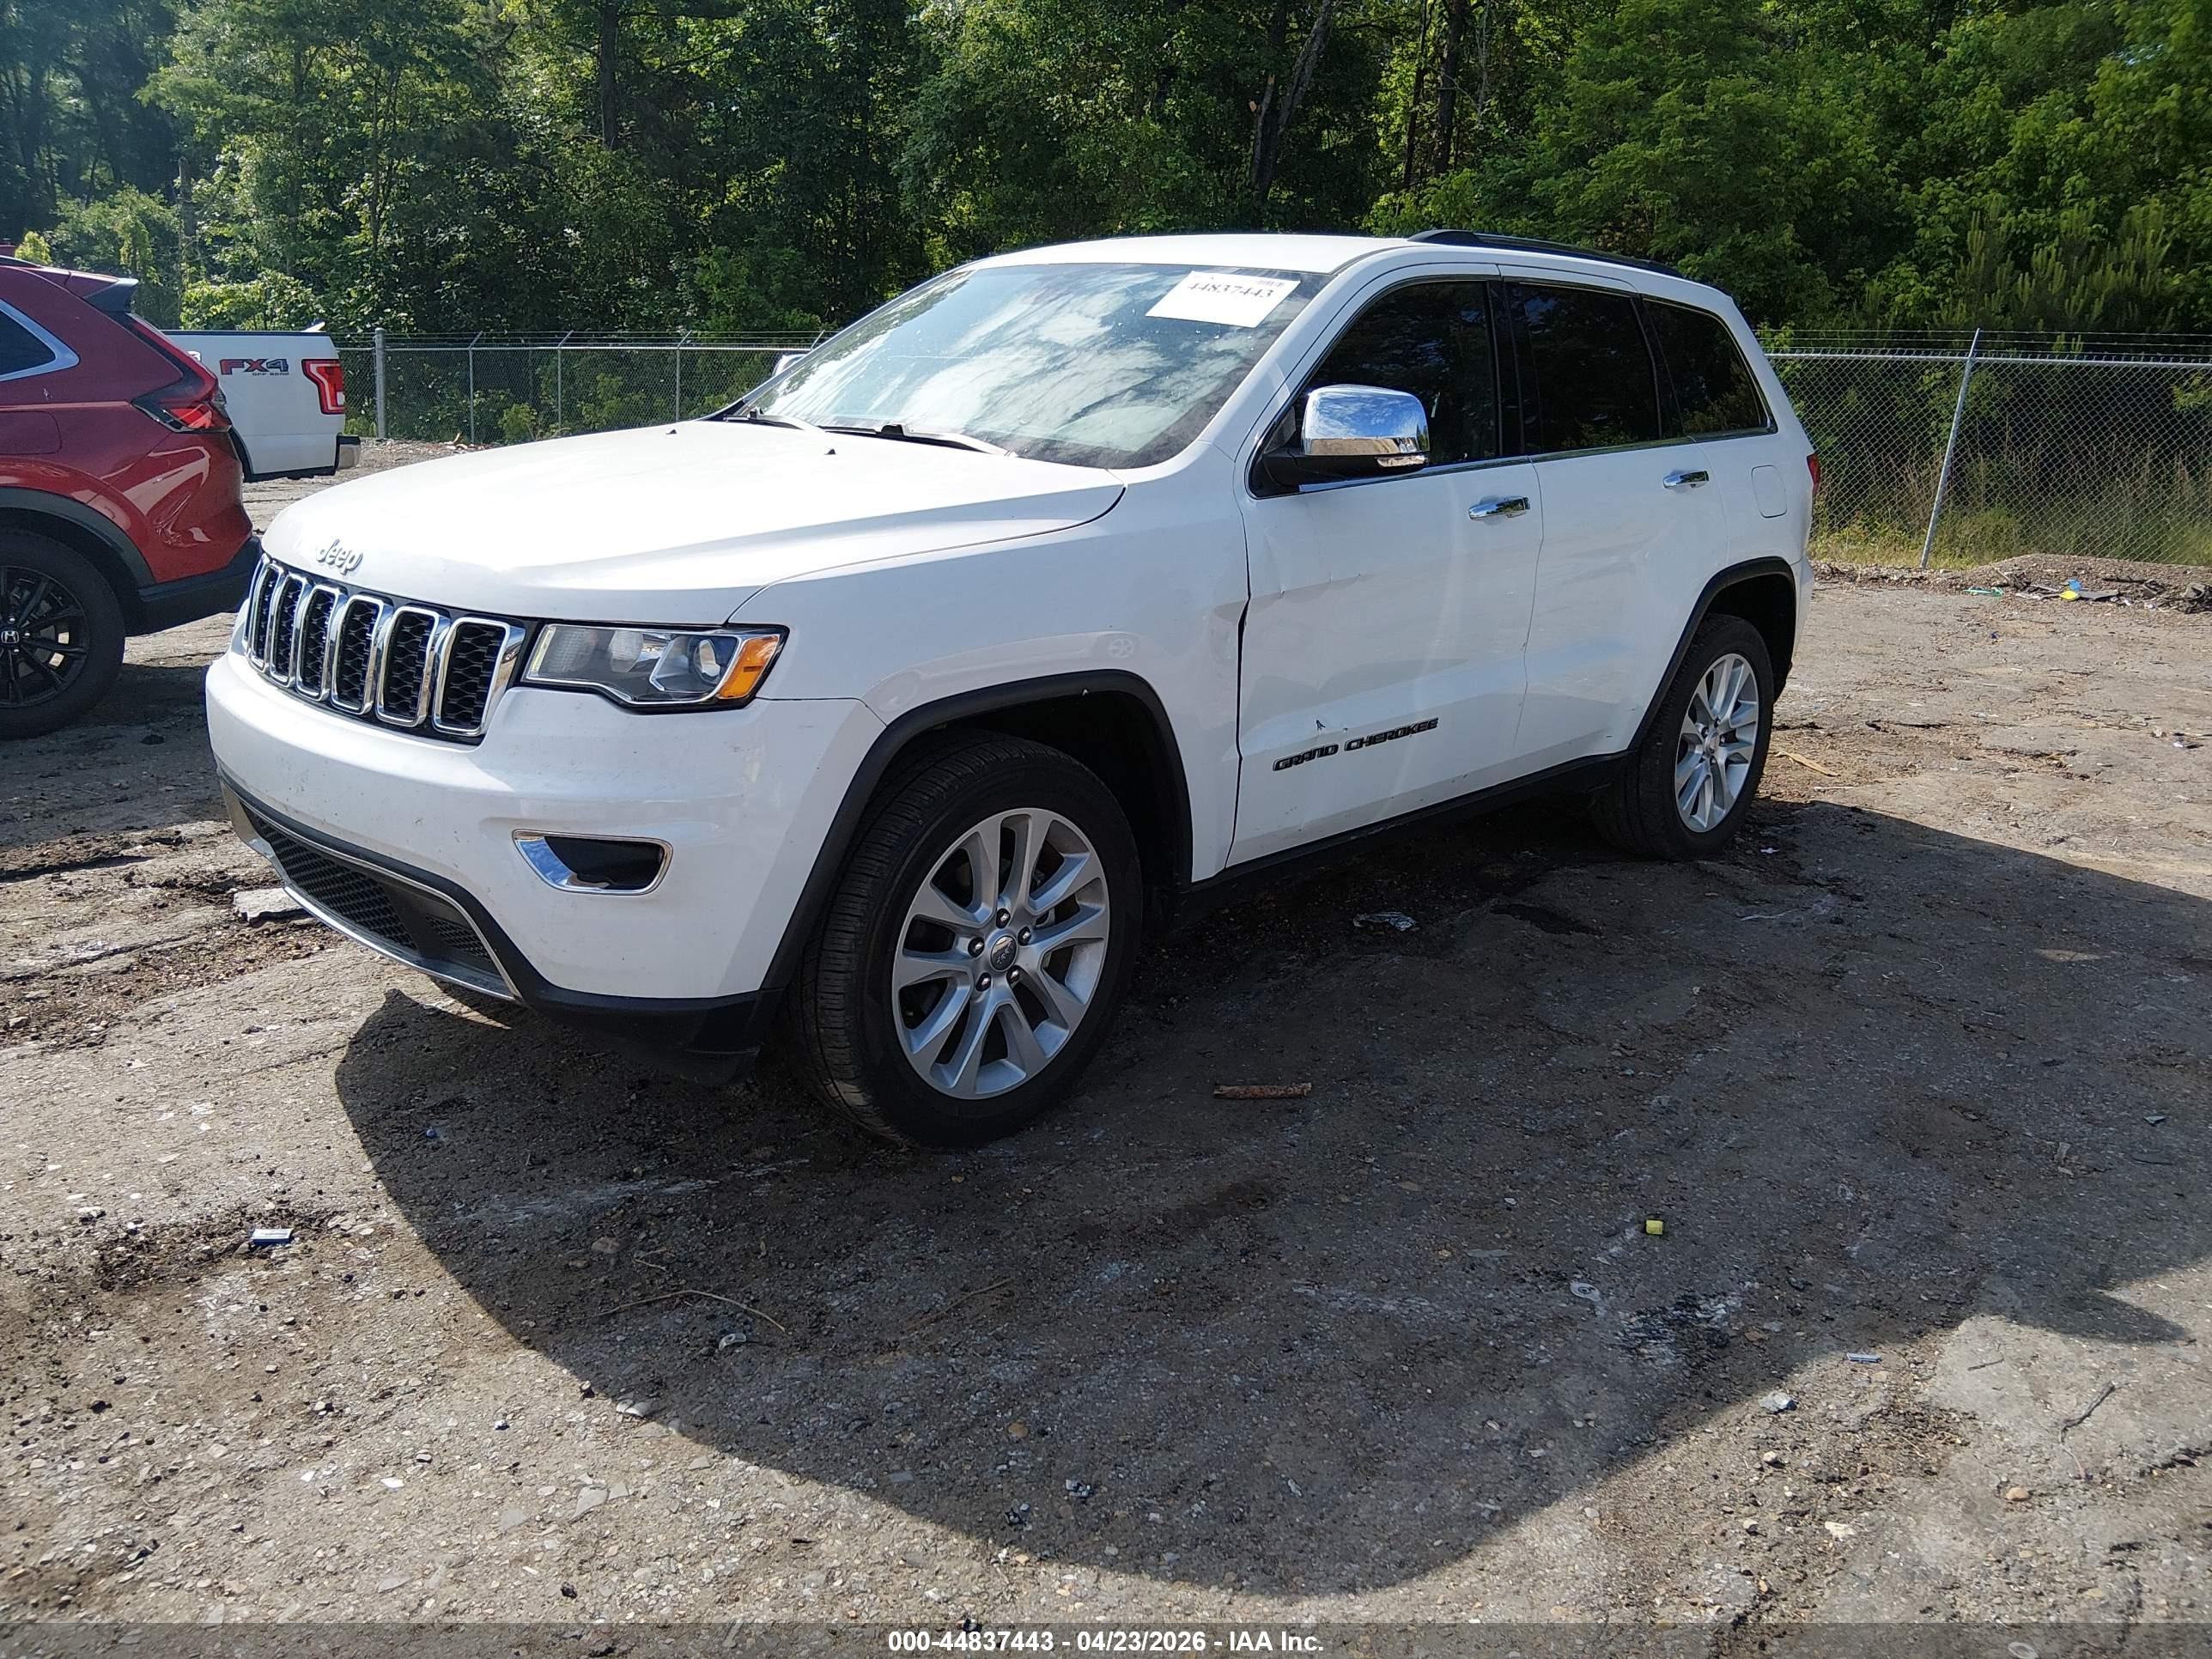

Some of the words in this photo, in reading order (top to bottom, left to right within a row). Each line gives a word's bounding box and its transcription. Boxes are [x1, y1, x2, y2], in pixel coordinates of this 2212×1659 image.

[220, 358, 289, 375] FX4
[315, 538, 363, 576] Jeep
[1273, 744, 1339, 771] GRAND
[1344, 717, 1439, 751] CHEROKEE
